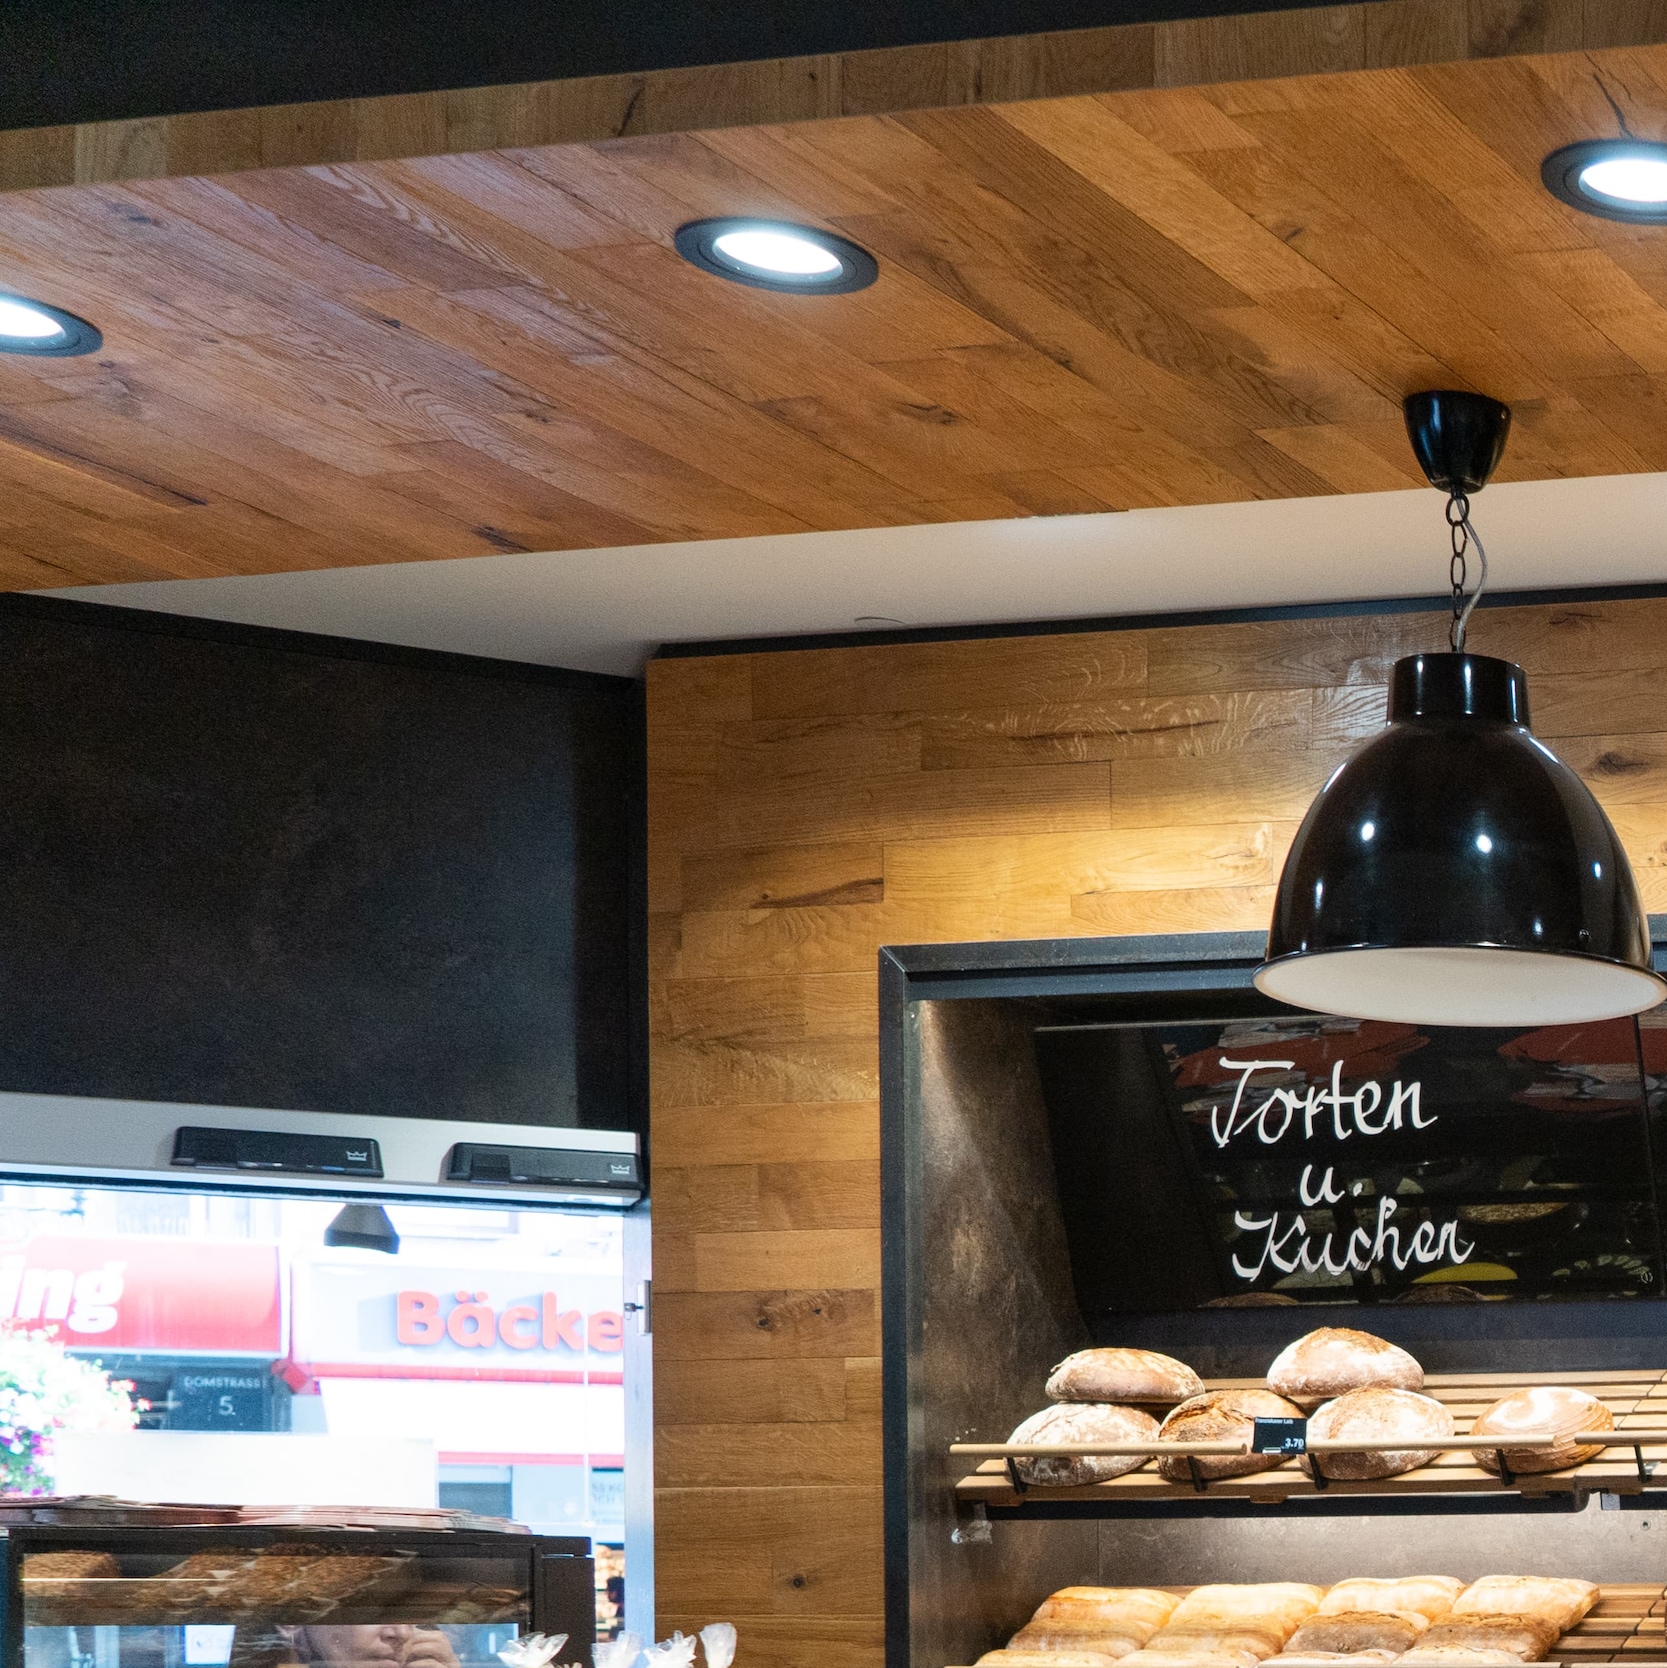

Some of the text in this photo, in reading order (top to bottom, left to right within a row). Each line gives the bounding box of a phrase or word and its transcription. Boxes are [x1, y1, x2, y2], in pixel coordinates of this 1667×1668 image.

[1211, 1056, 1438, 1148] Torten
[1300, 1163, 1363, 1206] u.
[1232, 1196, 1475, 1282] Kuchen
[397, 1290, 622, 1351] Bäcke
[1285, 1437, 1304, 1448] 3.70
